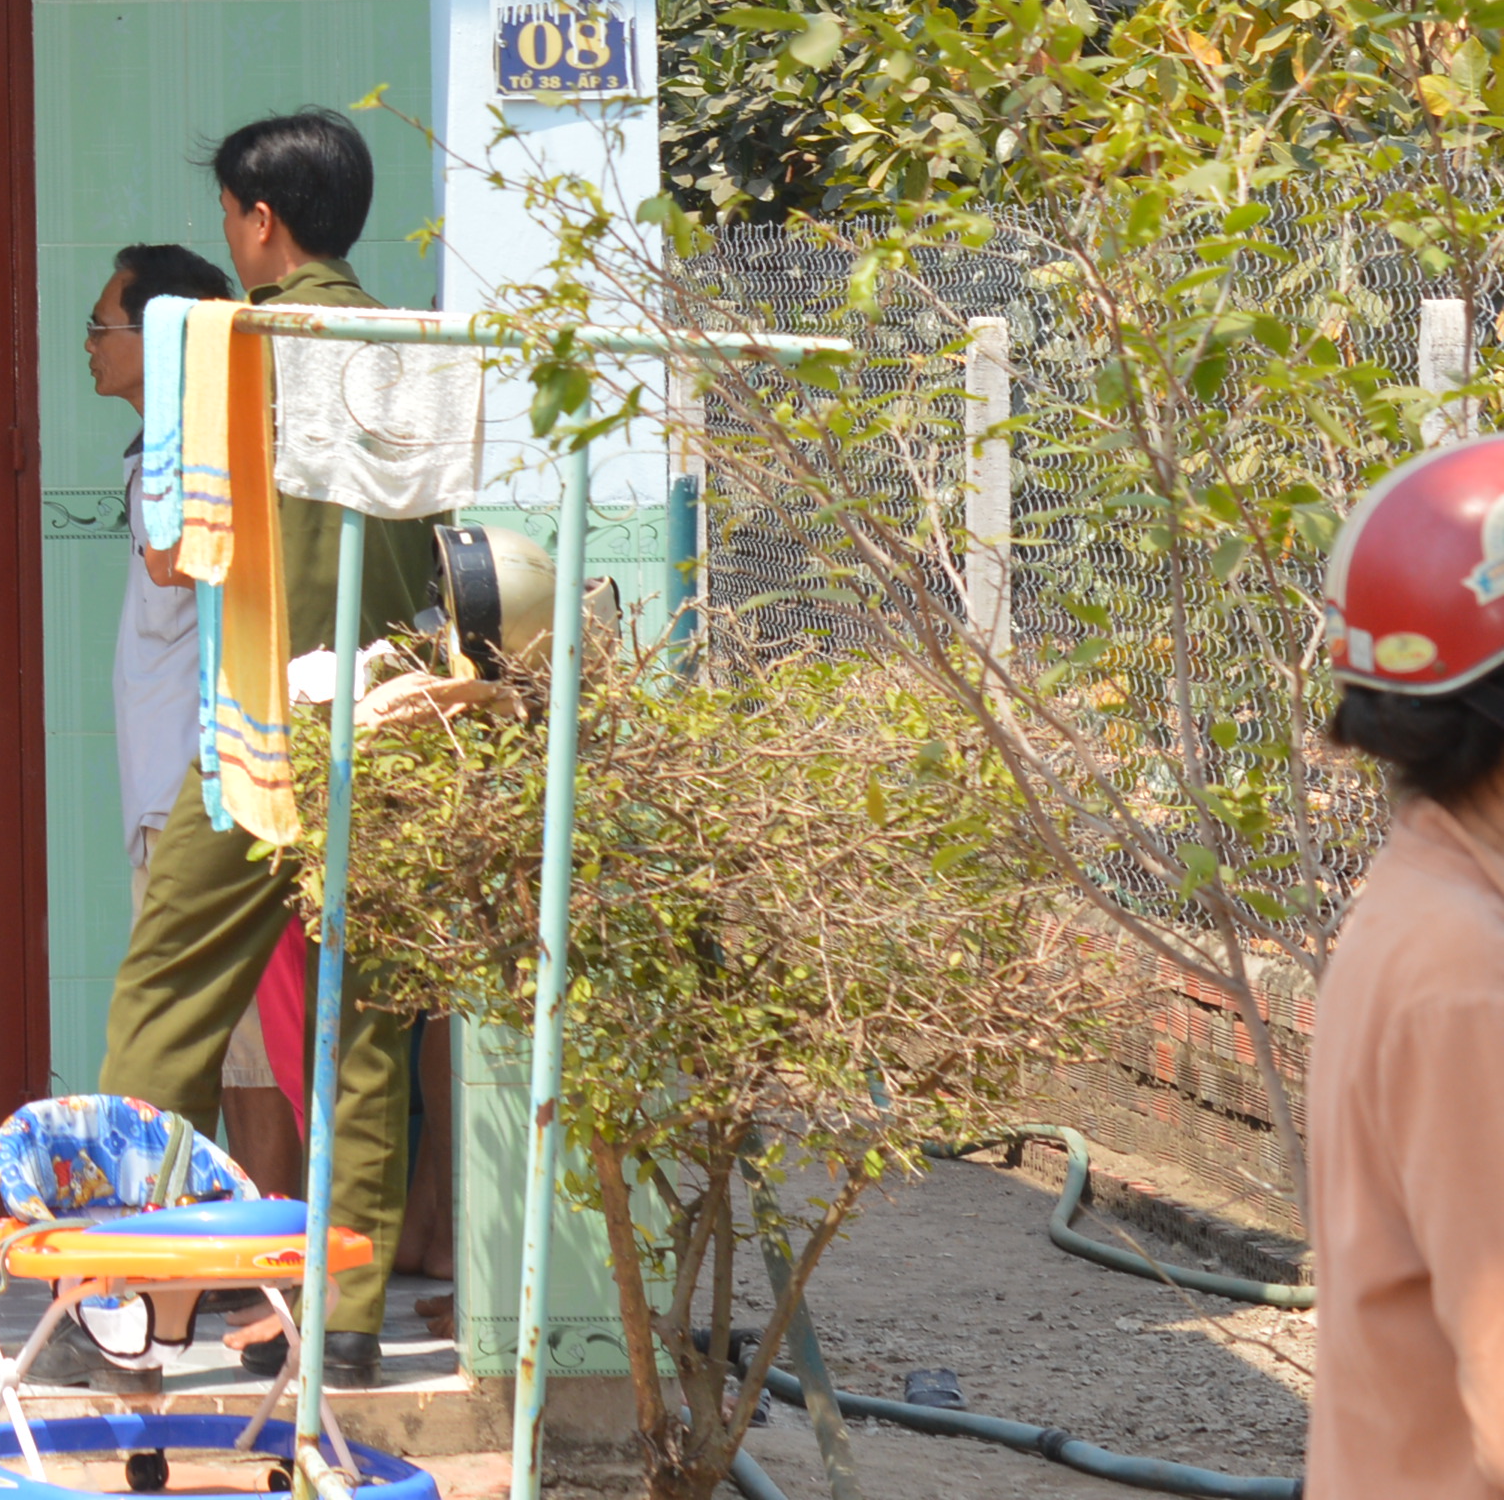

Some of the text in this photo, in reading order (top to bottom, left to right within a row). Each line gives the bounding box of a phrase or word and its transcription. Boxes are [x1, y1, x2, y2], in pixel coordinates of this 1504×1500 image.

[518, 20, 610, 70] 08
[538, 75, 562, 89] 38
[577, 70, 601, 89] ẤP
[606, 75, 619, 89] 3
